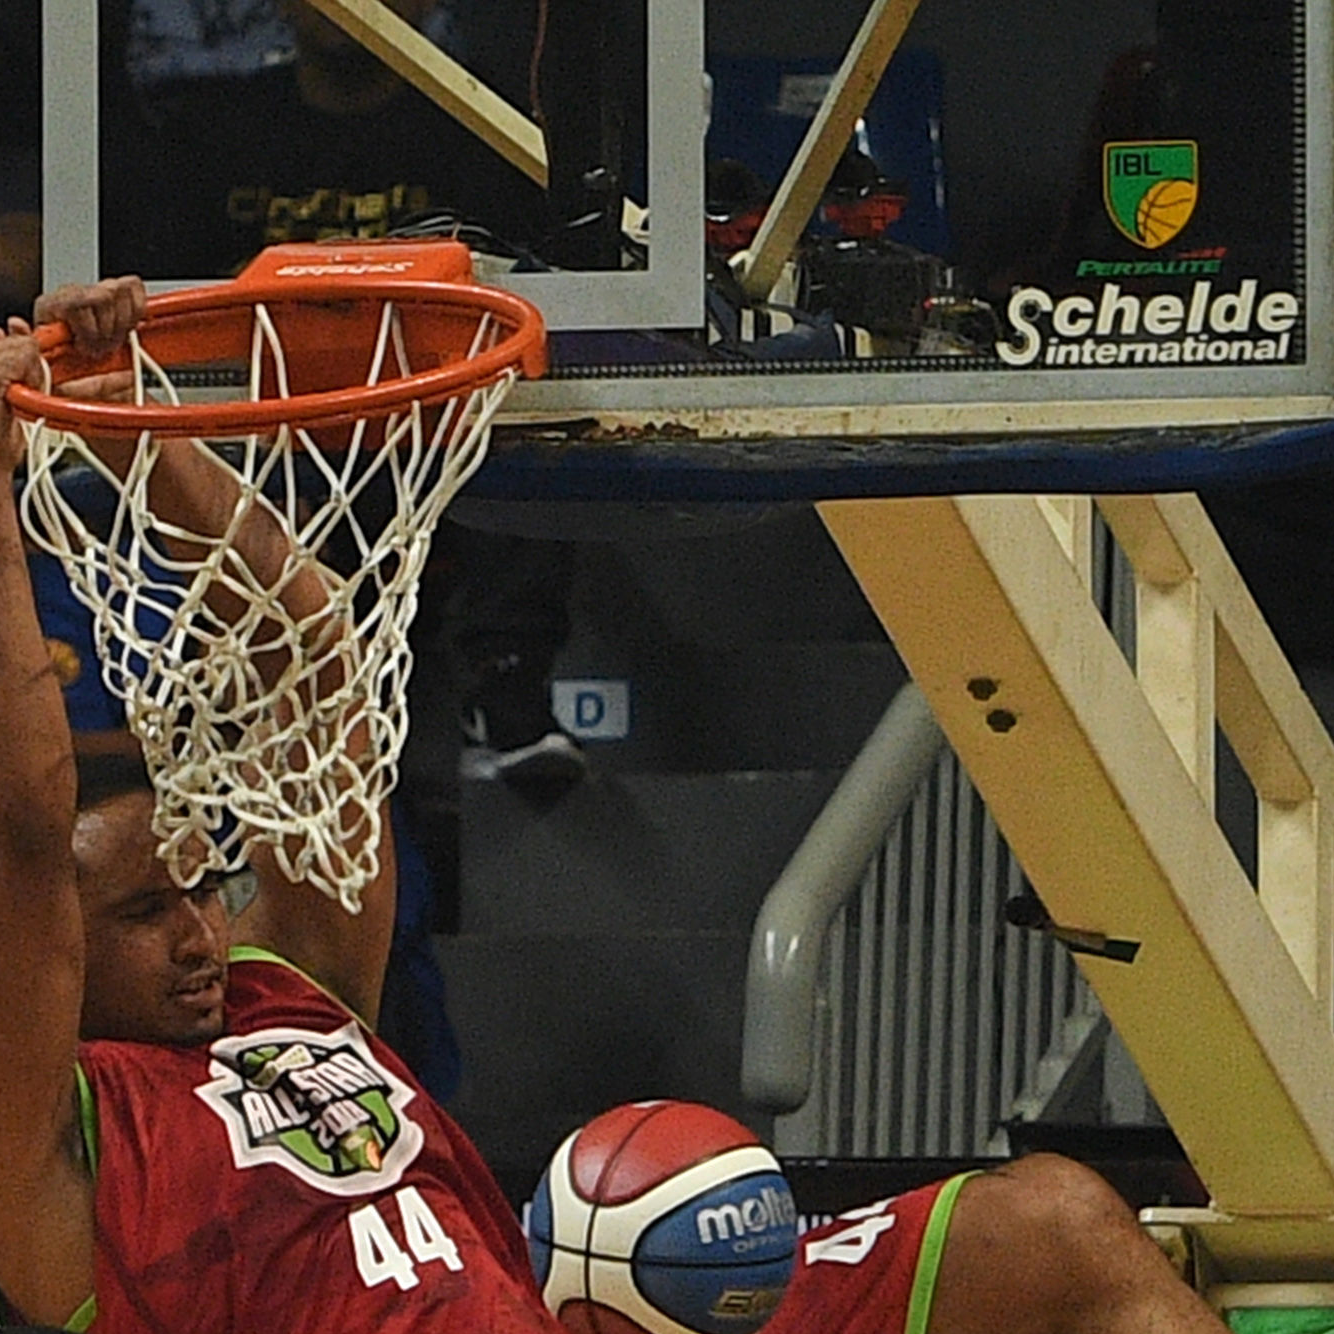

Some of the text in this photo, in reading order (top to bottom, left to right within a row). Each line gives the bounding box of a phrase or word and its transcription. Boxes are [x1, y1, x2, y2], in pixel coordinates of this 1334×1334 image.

[1114, 153, 1162, 176] IBL
[1076, 259, 1222, 276] PERTALITE
[995, 278, 1299, 366] Schelde
[1045, 332, 1290, 365] international
[575, 691, 605, 728] D
[348, 1185, 465, 1291] 44
